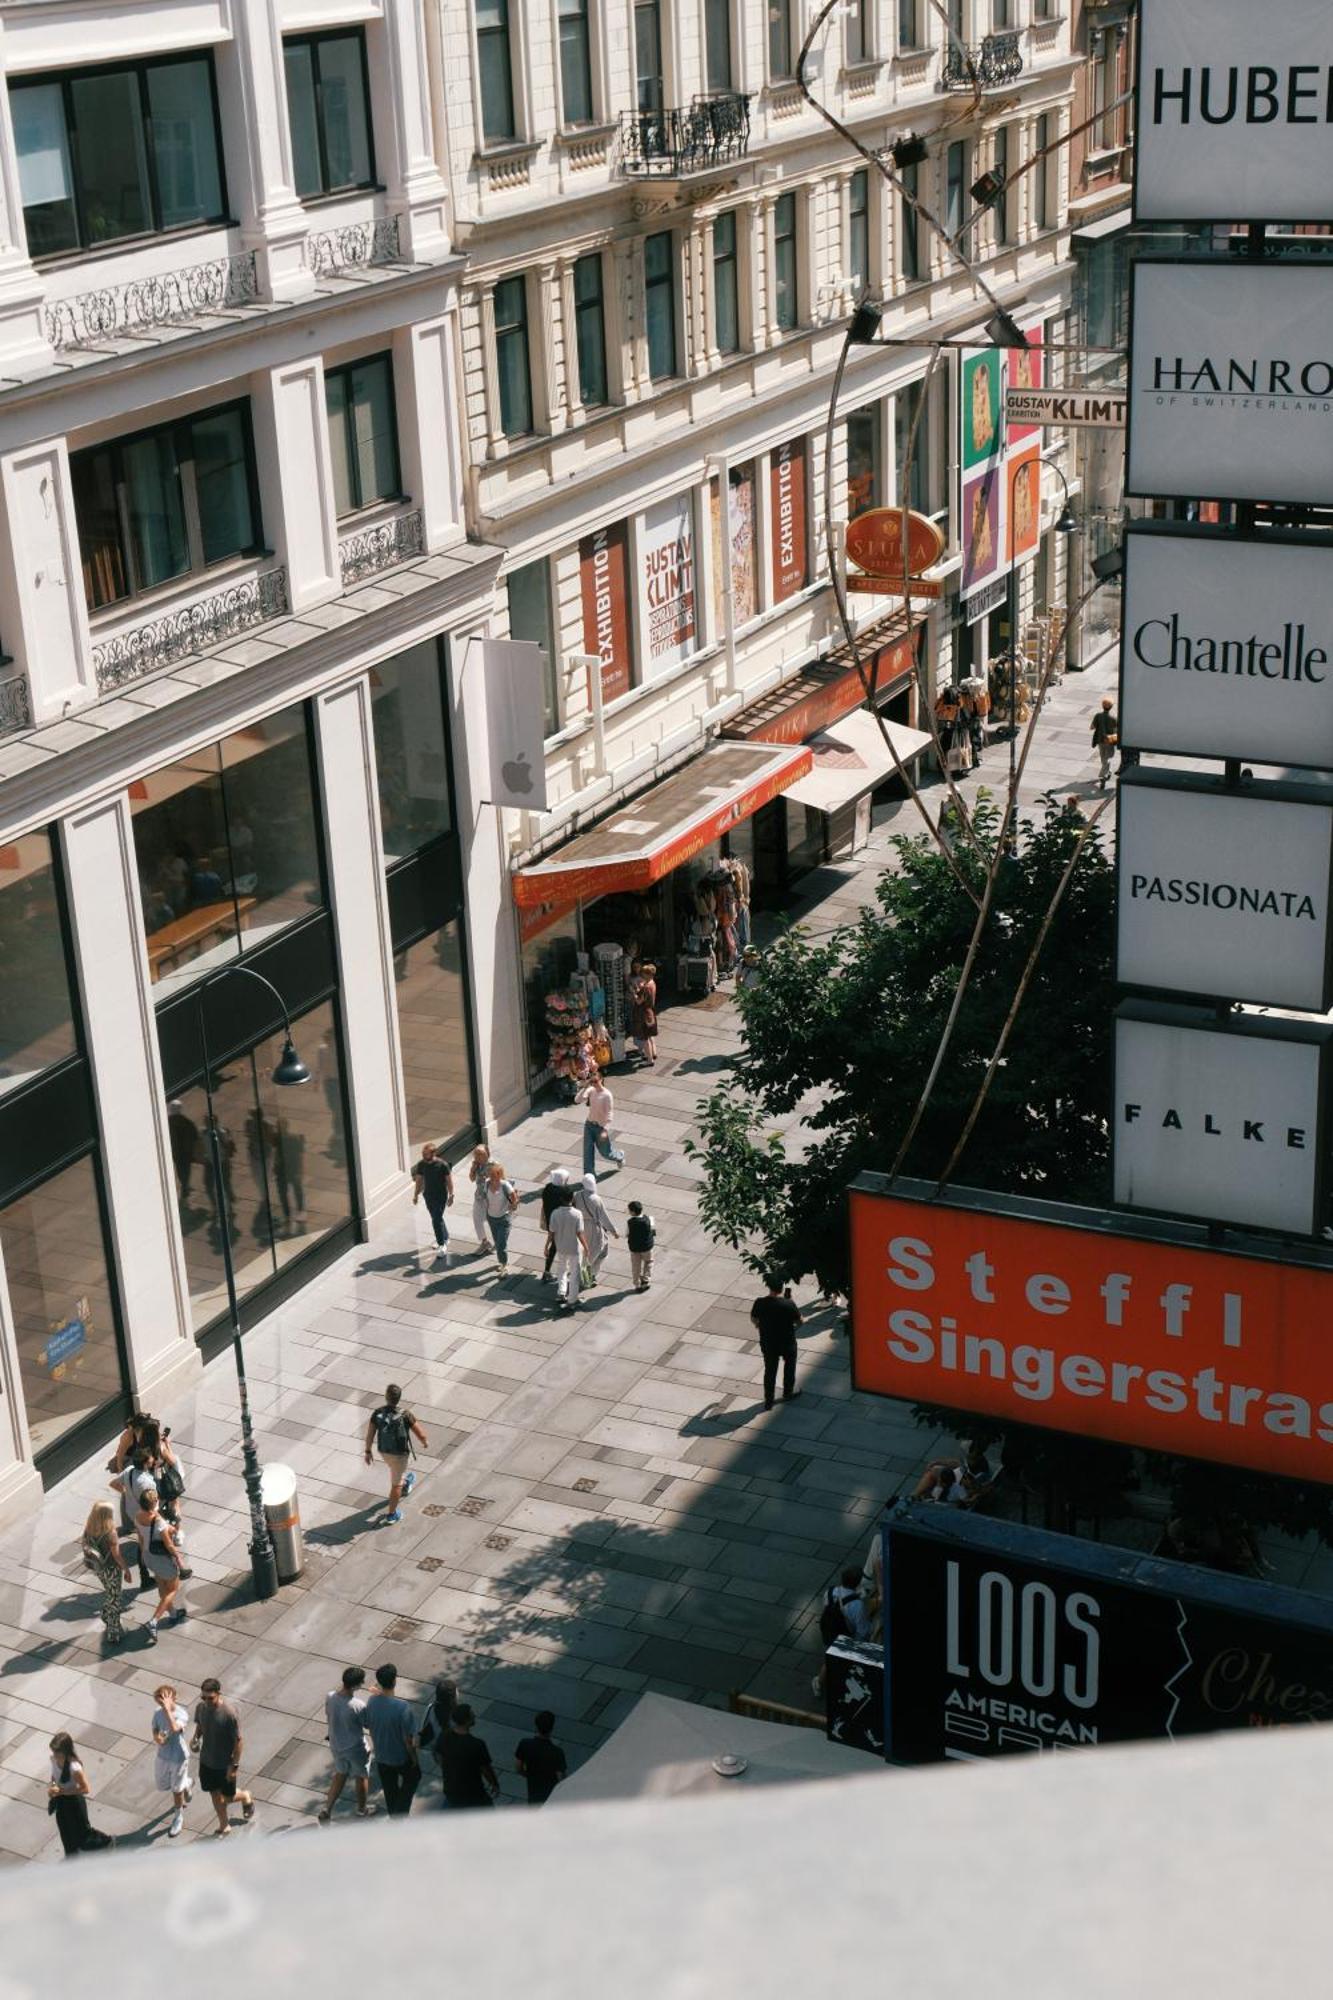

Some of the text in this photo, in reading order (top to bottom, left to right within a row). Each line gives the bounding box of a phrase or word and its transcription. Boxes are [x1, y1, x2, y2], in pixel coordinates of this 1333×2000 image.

[1154, 356, 1333, 396] HANRO
[1007, 396, 1127, 422] GUSTAV KLIMT
[1156, 397, 1331, 412] OF SWITZERLAND
[779, 441, 793, 568] EXHIBITION
[593, 529, 615, 670] EXHIBITION
[1134, 613, 1328, 684] Chantelle
[1131, 874, 1316, 921] PASSIONATA
[1125, 1103, 1306, 1150] FALKE
[887, 1236, 1242, 1347] Steffl
[946, 1560, 1101, 1709] LOOS
[944, 1688, 1099, 1744] AMERICAN
